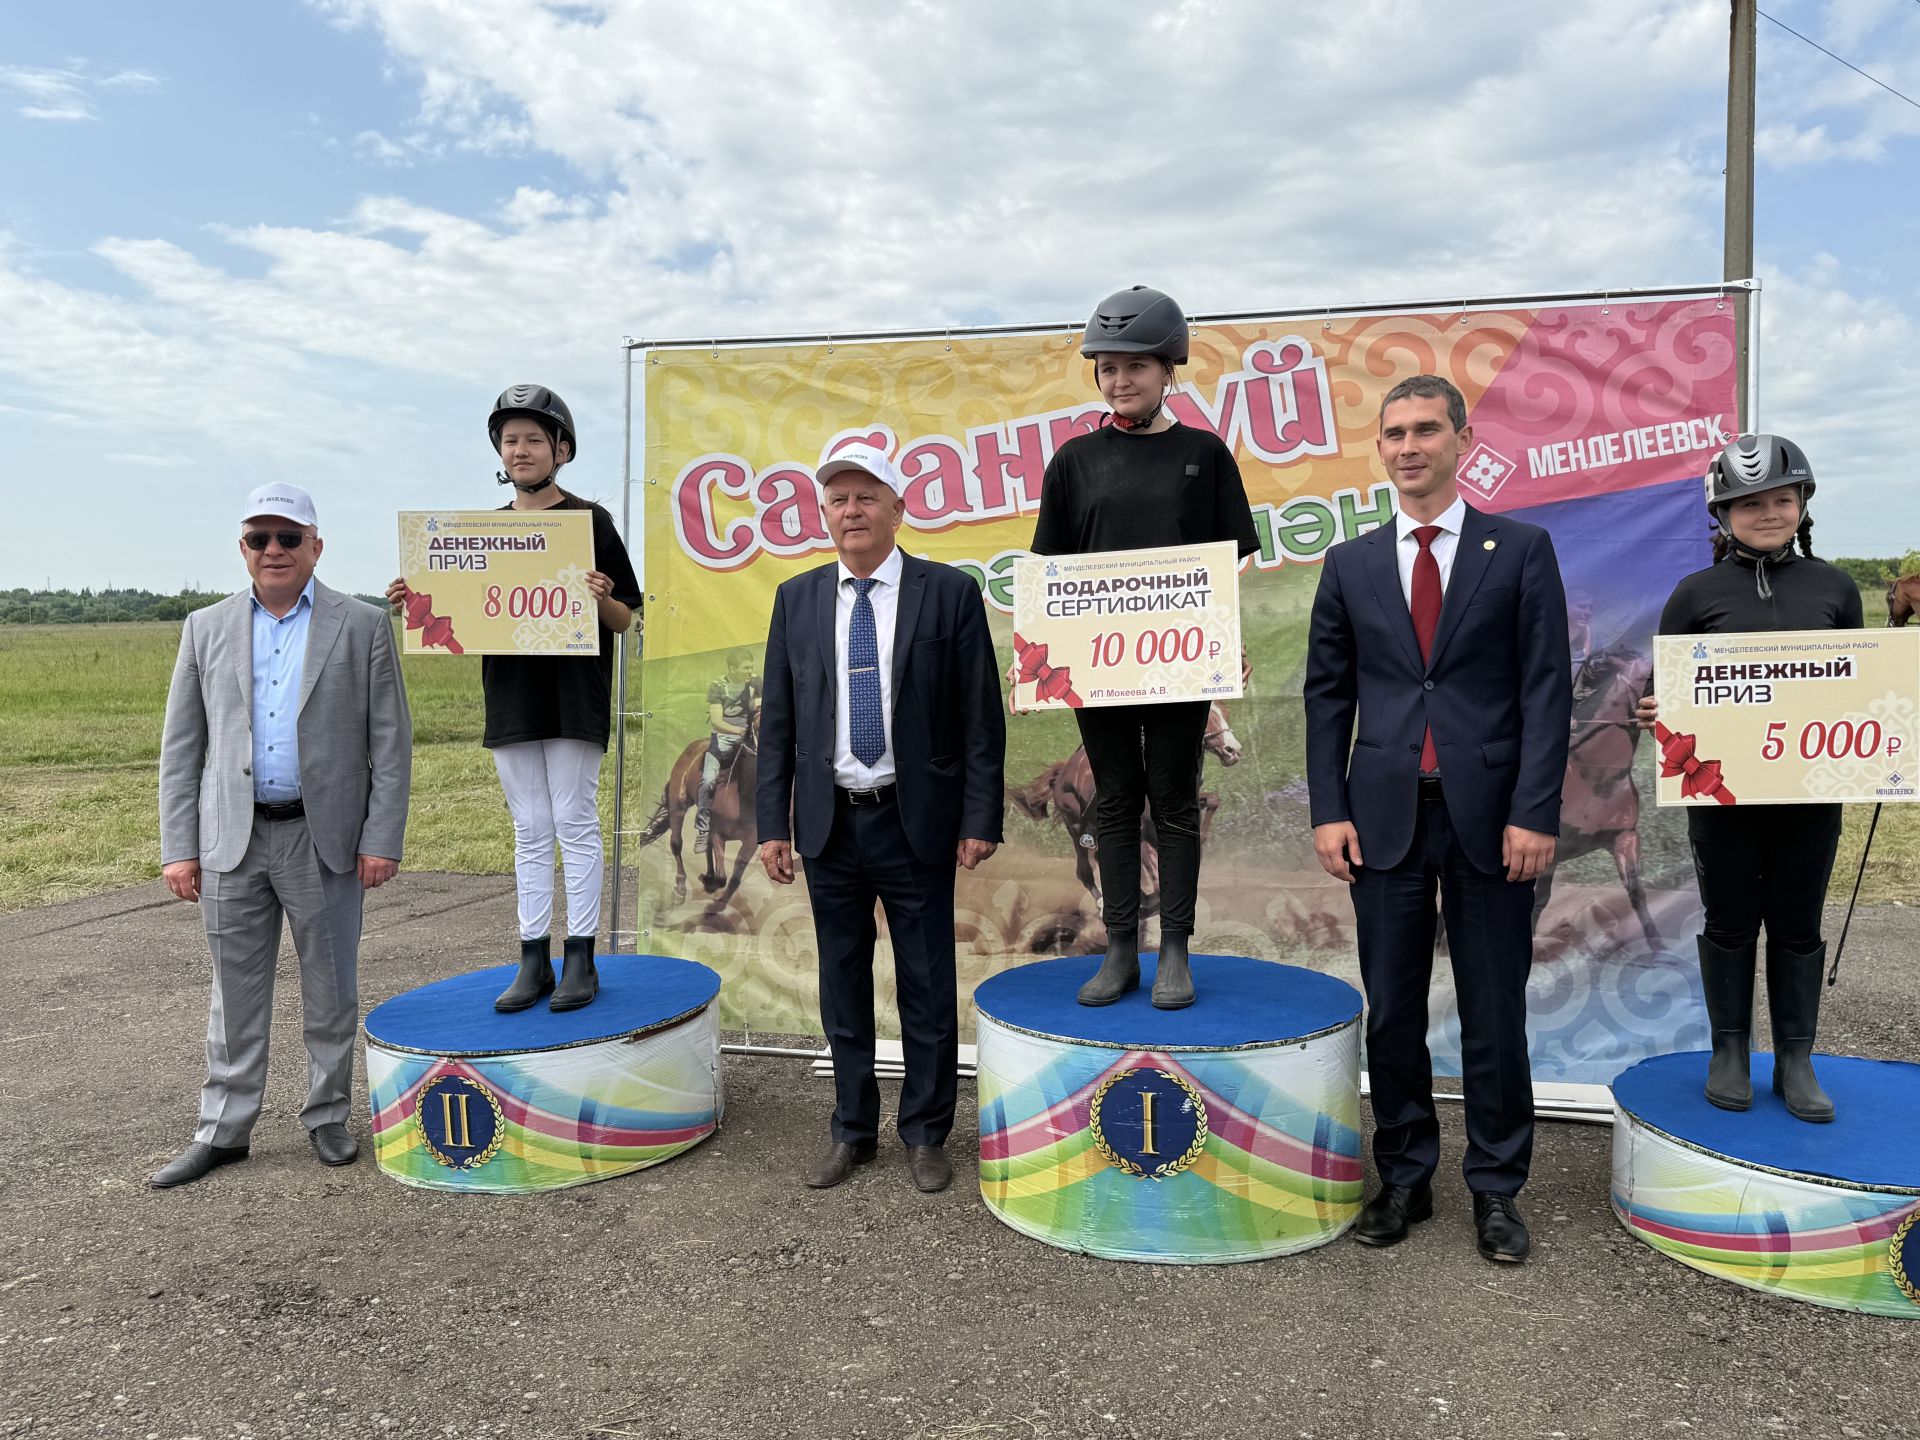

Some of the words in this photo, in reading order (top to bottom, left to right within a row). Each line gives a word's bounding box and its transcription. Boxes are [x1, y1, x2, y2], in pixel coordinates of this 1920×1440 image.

[1527, 414, 1728, 479] МЕНДЕЛЕЕВСК
[429, 533, 546, 551] ДЕНЕЖНЫЙ
[429, 554, 488, 570] ПРИЗ
[1063, 562, 1118, 572] МЕНДЕЛЕЕВСКИЙ
[1119, 558, 1178, 568] МУНИЦИПАЛЬНЫЙ
[1047, 568, 1208, 597] ПОДАРОЧНЫЙ
[484, 585, 502, 618] 8
[508, 586, 568, 619] 000
[1046, 590, 1212, 617] СЕРТИФИКАТ
[1091, 632, 1125, 668] 10
[1135, 626, 1204, 665] 000
[1714, 644, 1779, 654] МЕНДЕЛЕЕВСКИЙ
[1780, 642, 1851, 652] МУНИЦИПАЛЬНЫЙ
[1852, 641, 1879, 649] РАЙОН
[1694, 656, 1851, 684] ДЕНЕЖНЫЙ
[1090, 689, 1104, 698] ИП
[1106, 688, 1147, 698] Мокеева
[1149, 686, 1169, 695] А.В.
[1694, 684, 1772, 705] ПРИЗ
[1761, 721, 1787, 761] 5
[1799, 719, 1882, 760] 000
[438, 1092, 476, 1148] II
[1136, 1091, 1160, 1155] I
